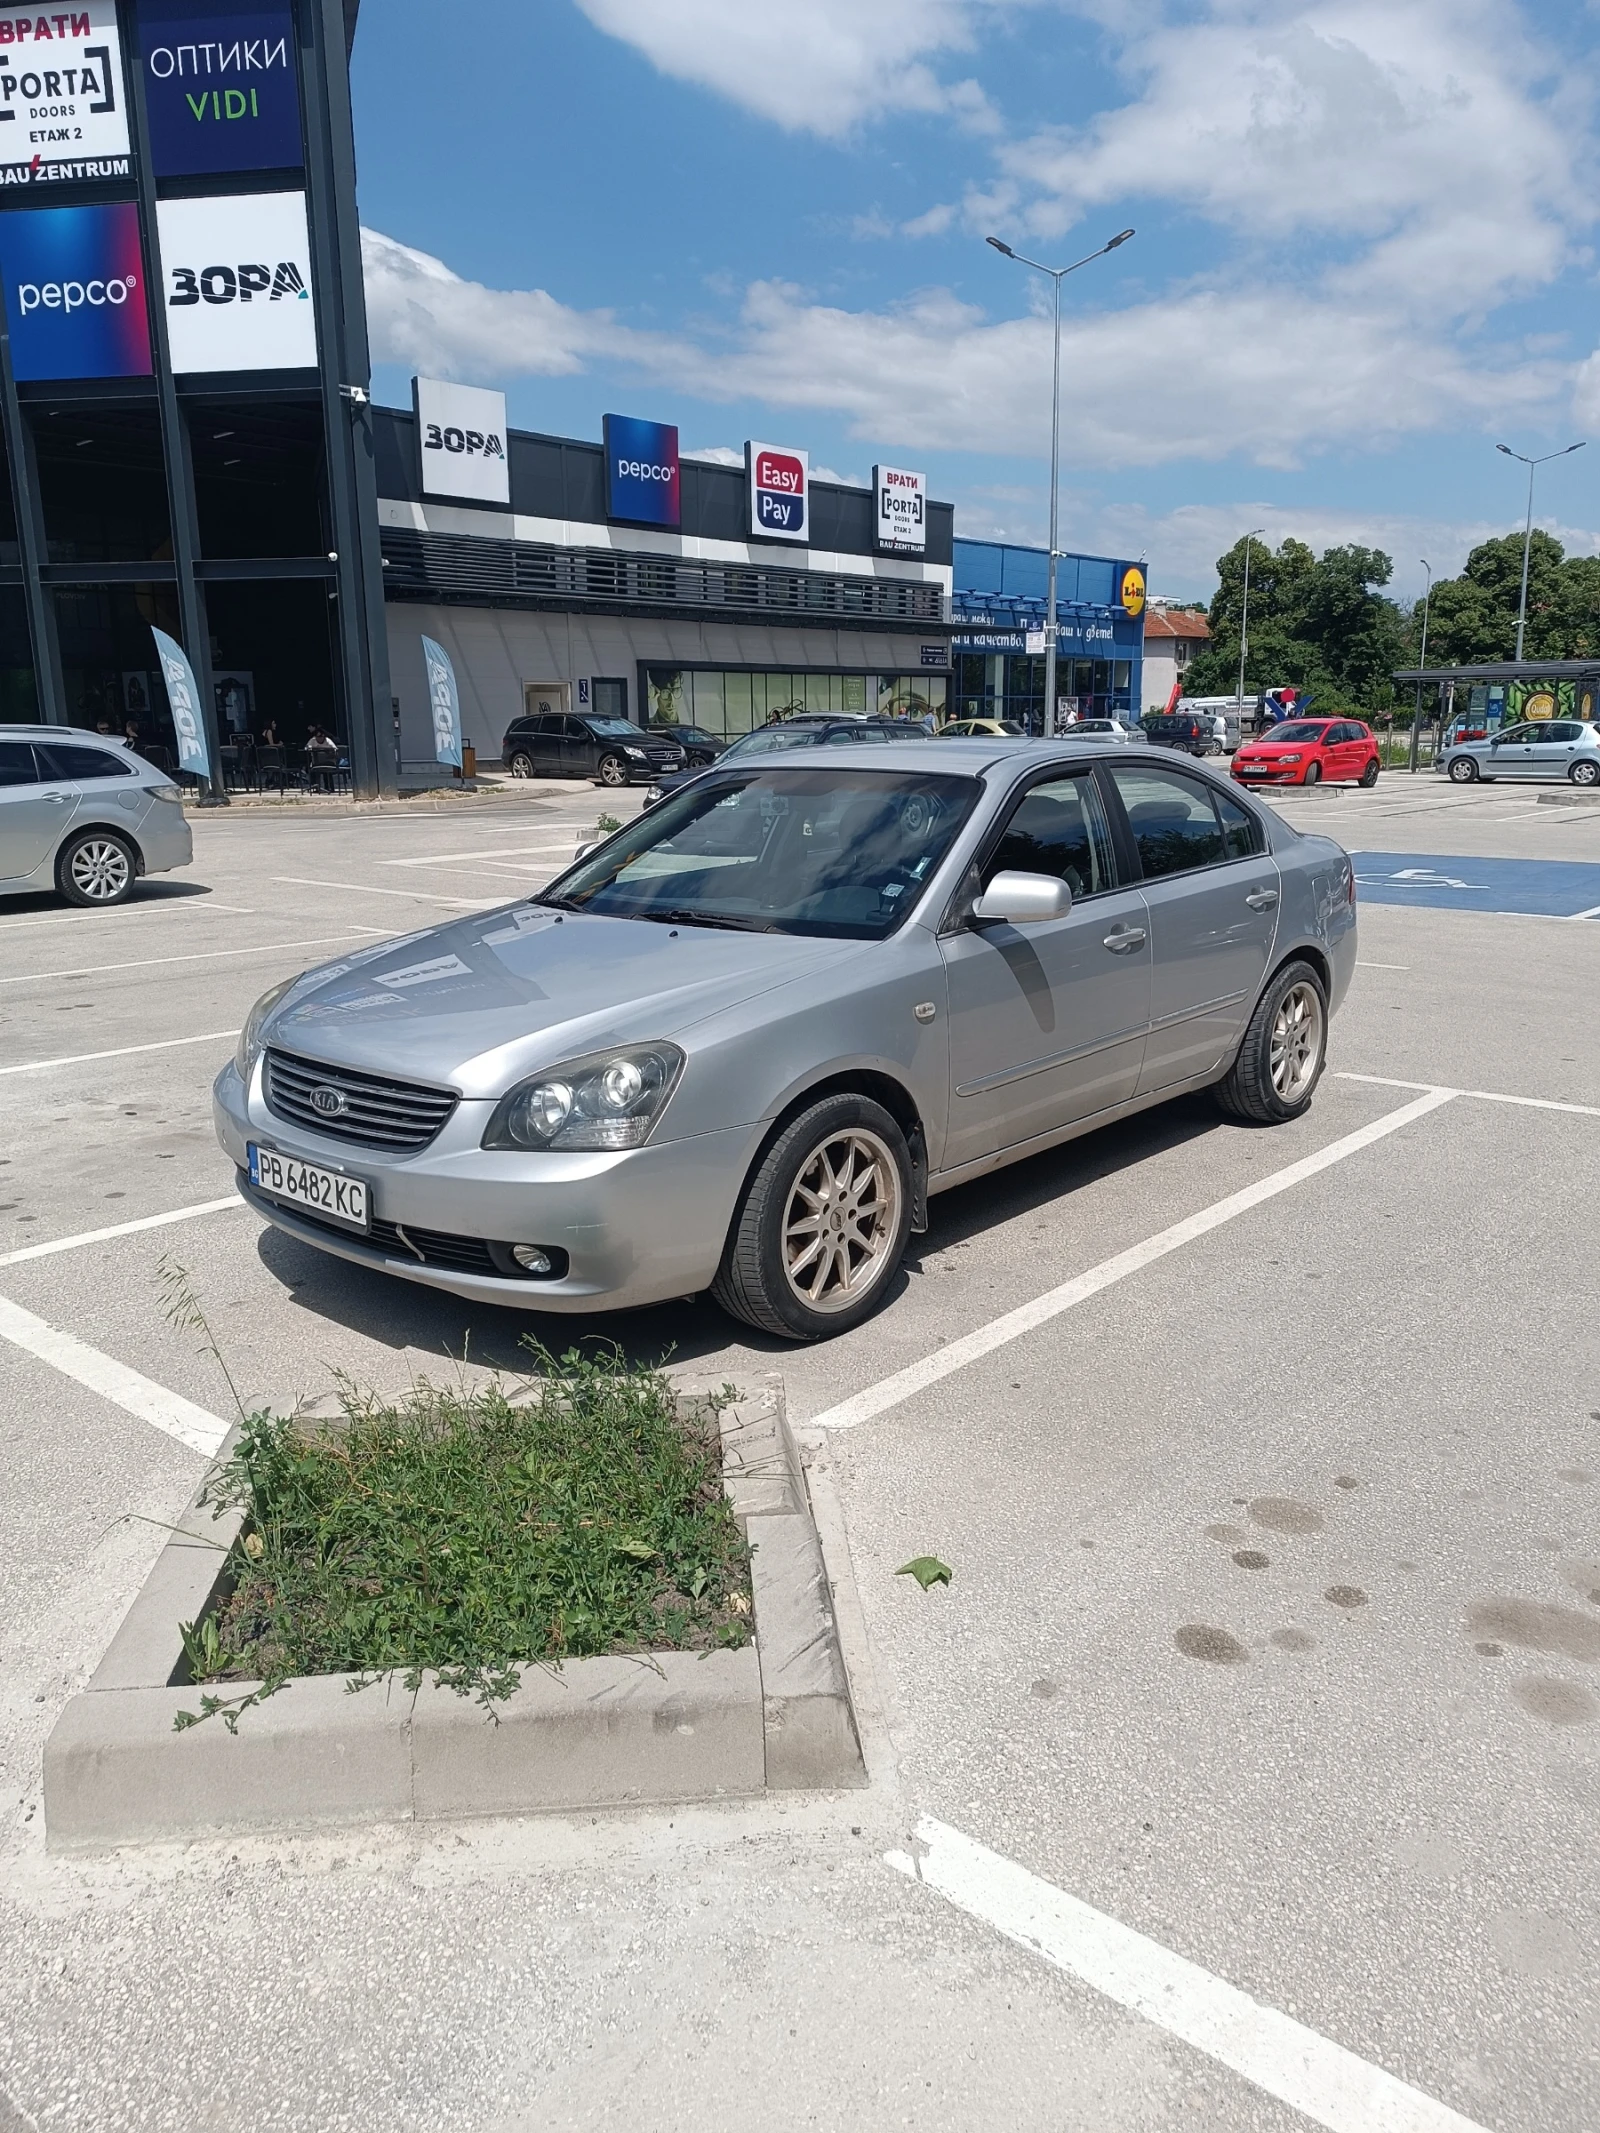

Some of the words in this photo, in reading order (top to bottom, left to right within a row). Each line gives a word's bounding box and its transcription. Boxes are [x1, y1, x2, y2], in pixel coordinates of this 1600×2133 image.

[0, 12, 91, 44] ВРАТИ
[150, 37, 287, 78] ОПТИКИ
[1, 68, 101, 101] PORTA
[30, 104, 76, 119] DOORS
[185, 88, 258, 121] VIDI
[29, 128, 70, 143] ЕТАЖ
[74, 127, 83, 140] 2
[0, 167, 30, 185] AU
[34, 159, 129, 181] ZENTRUM
[169, 262, 309, 306] ЗОРА
[424, 423, 505, 460] ЗОРА
[762, 461, 799, 492] Easy
[886, 472, 918, 489] ВРАТИ
[763, 495, 791, 525] Pay
[886, 497, 919, 515] PORTA
[879, 540, 893, 549] BAU
[893, 542, 925, 552] ZENTRUM
[313, 1091, 335, 1111] KIA
